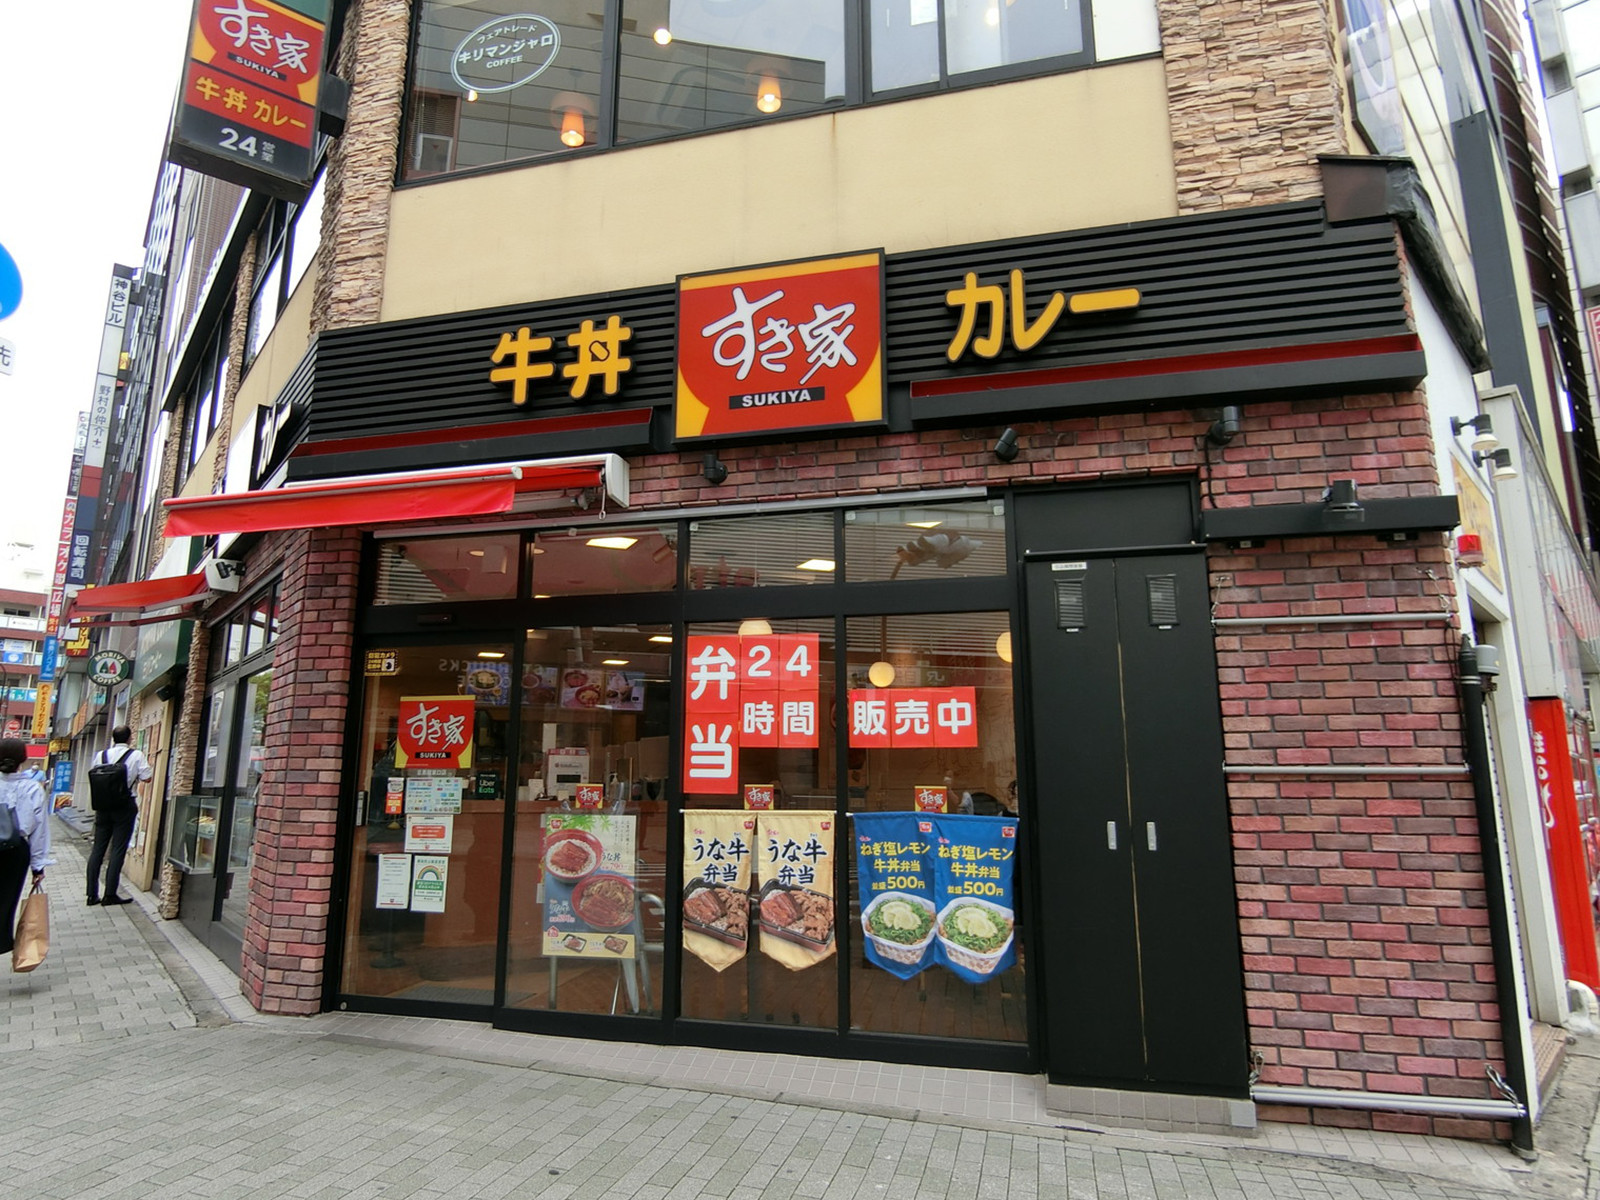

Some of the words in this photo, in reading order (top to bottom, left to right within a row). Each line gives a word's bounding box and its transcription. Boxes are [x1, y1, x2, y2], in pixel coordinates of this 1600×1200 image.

[213, 0, 310, 74] すき家
[477, 24, 538, 44] フェアトレード
[458, 34, 553, 64] キリマンジャロ
[486, 55, 523, 69] COFFEE
[235, 56, 280, 79] SUKIYA
[195, 76, 248, 113] 牛丼
[253, 99, 307, 127] カレー
[219, 127, 258, 157] 24
[108, 278, 128, 325] 神谷ビル
[946, 268, 1141, 363] カレー
[701, 286, 858, 386] すき家
[489, 314, 633, 406] 牛丼
[741, 389, 812, 409] SUKIYA
[70, 534, 90, 580] 回転寿司
[94, 651, 126, 665] MORIVA
[747, 644, 812, 677] 24
[93, 674, 122, 684] COFFEE
[690, 645, 736, 779] 弁当
[743, 700, 814, 736] 時間
[852, 698, 973, 736] 販売中
[406, 702, 466, 750] すき家
[479, 779, 496, 787] Uber
[692, 837, 750, 862] うな牛
[767, 838, 828, 864] うな牛
[860, 841, 931, 857] ねぎ塩レモン
[938, 844, 1014, 861] ねぎ塩レモン
[703, 862, 739, 884] 弁当
[777, 864, 816, 886] 弁当
[873, 857, 922, 873] 牛丼弁当
[950, 862, 1001, 879] 牛丼弁当
